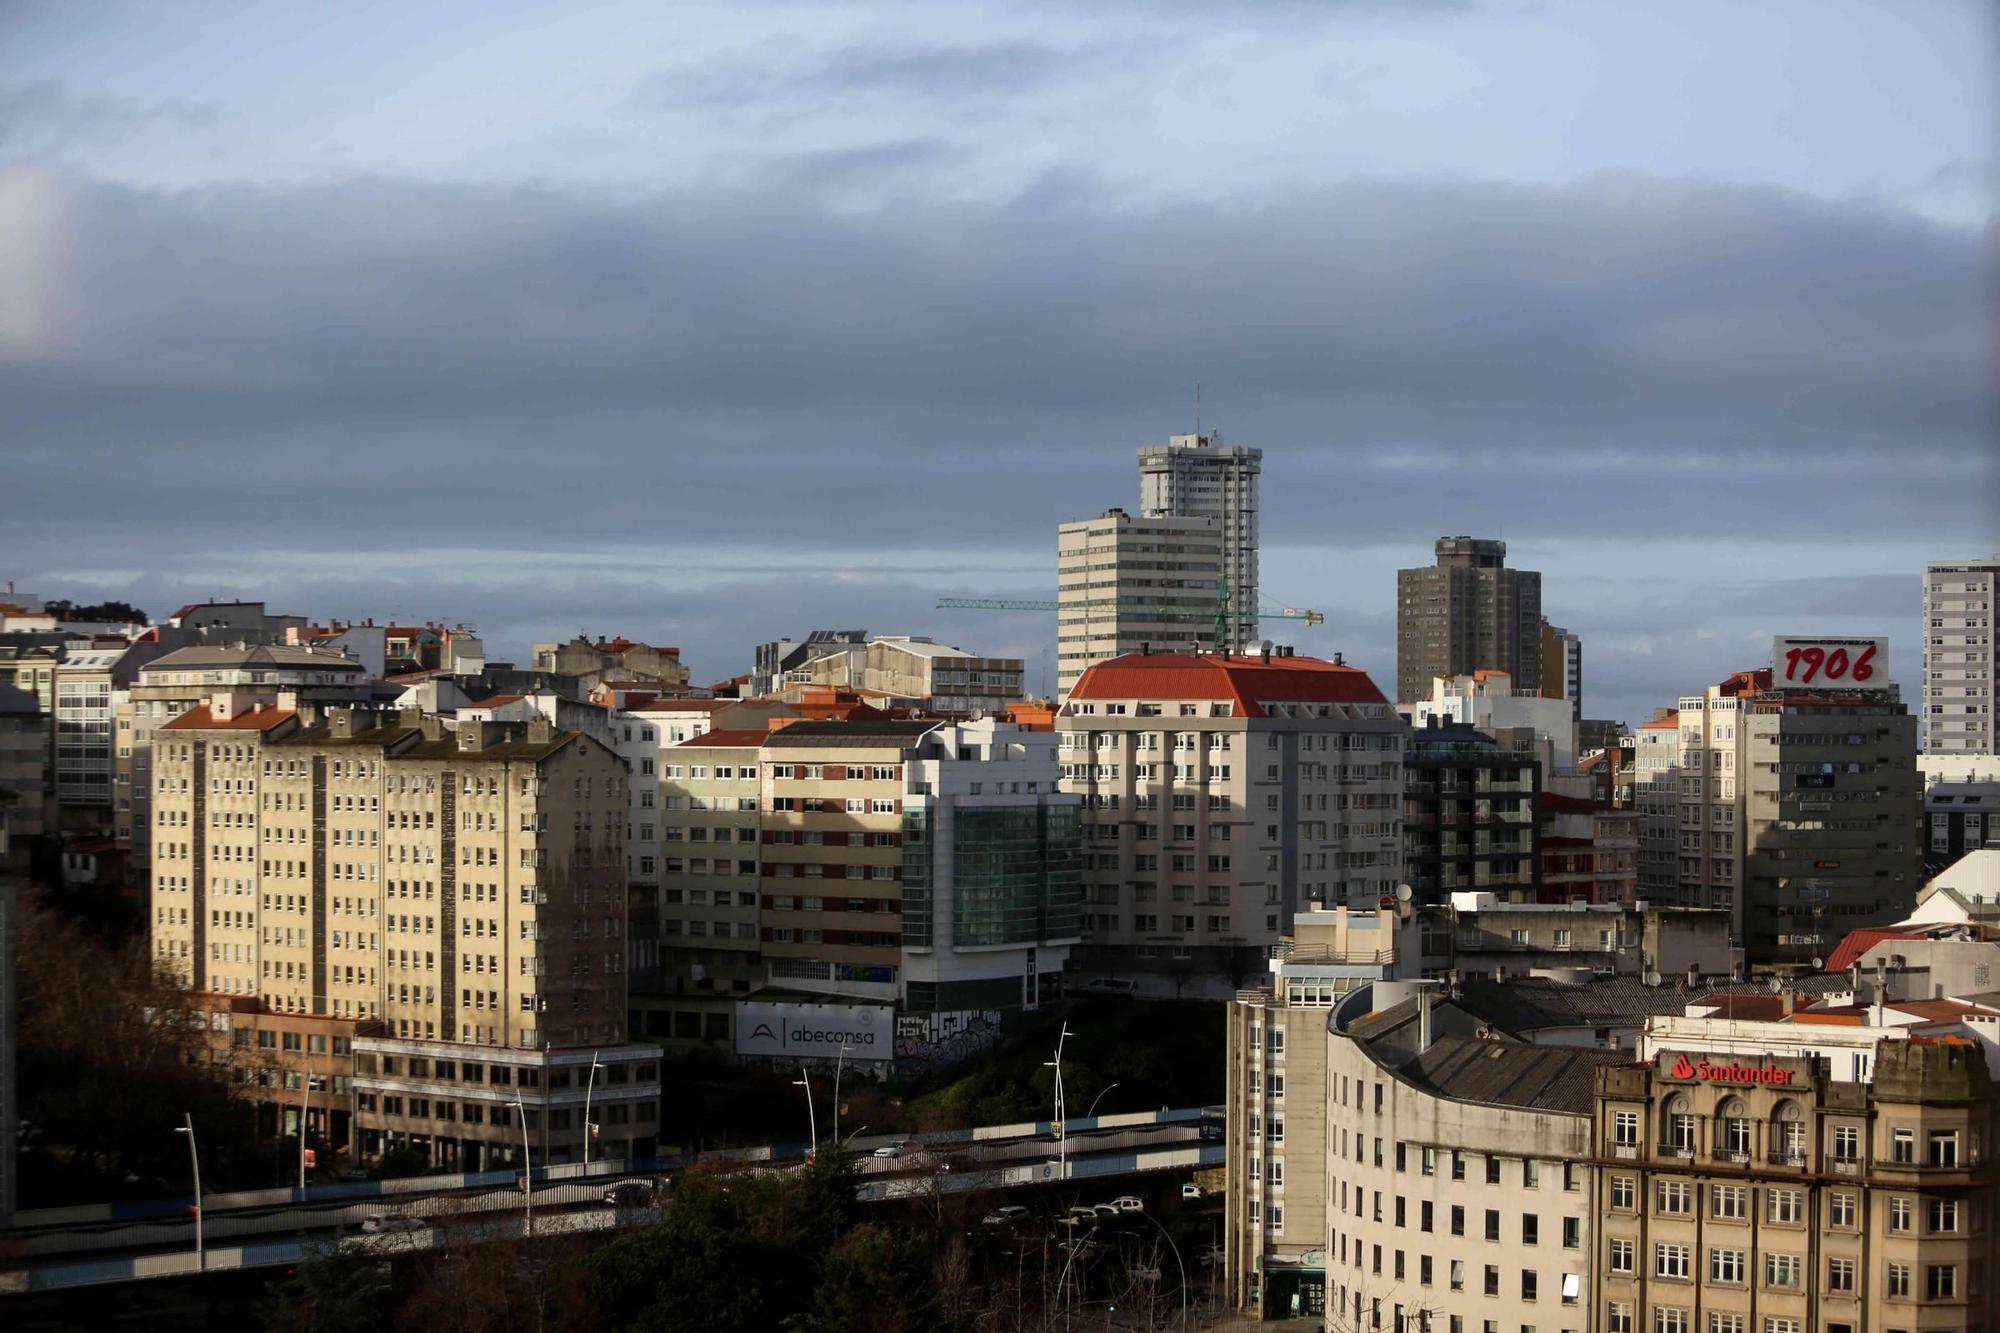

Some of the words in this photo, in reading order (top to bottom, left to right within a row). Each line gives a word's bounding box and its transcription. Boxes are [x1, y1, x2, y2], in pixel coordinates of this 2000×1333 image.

[1786, 645, 1877, 684] 1906
[791, 1025, 874, 1044] abeconsa
[1697, 1060, 1794, 1084] Santander
